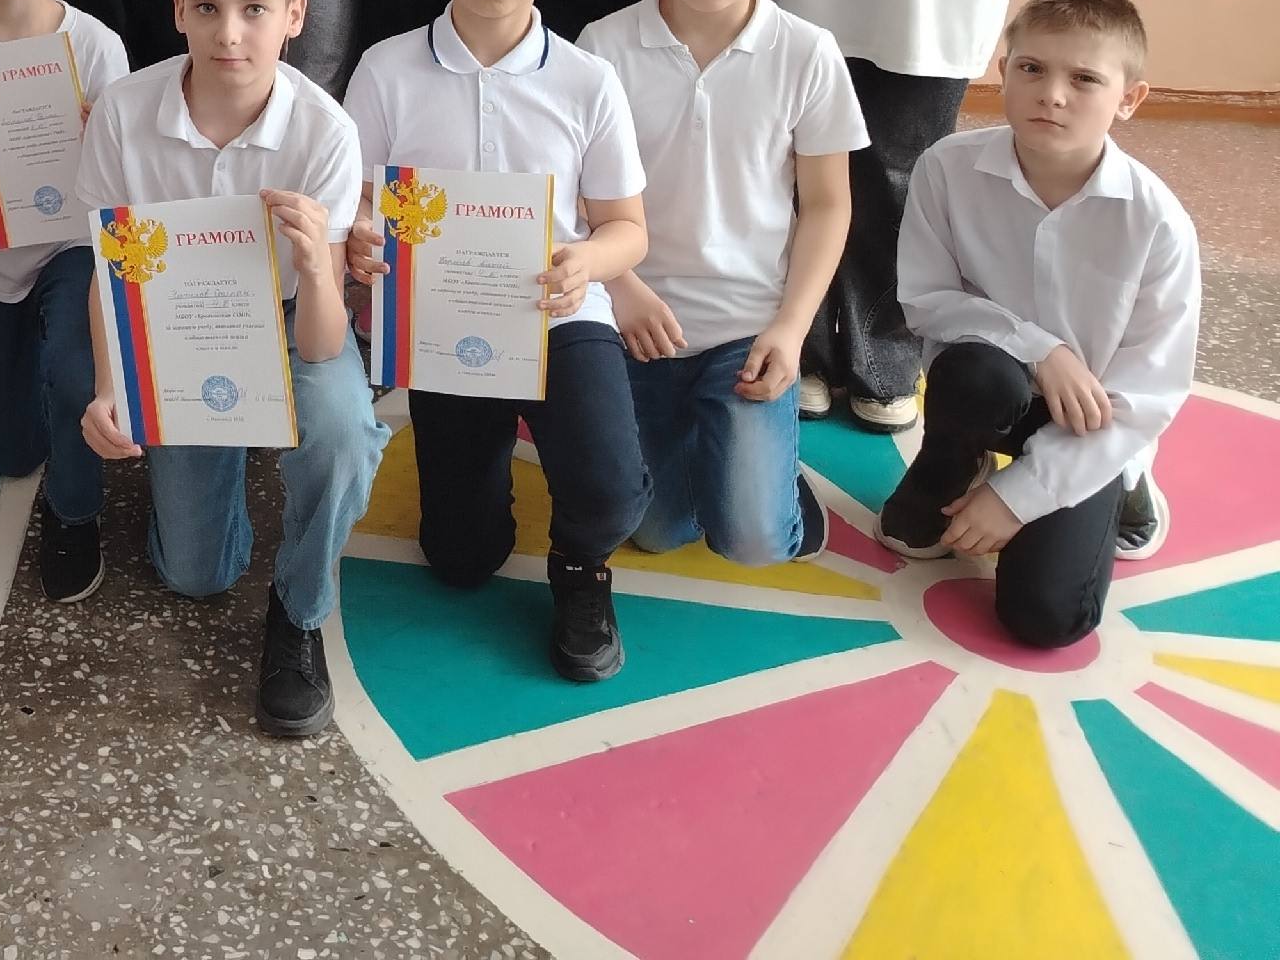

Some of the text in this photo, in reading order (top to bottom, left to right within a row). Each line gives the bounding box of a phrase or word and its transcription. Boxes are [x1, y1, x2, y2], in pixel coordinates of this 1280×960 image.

[2, 62, 63, 81] ГРАМОТА
[455, 203, 535, 220] ГРАМОТА
[176, 230, 256, 246] ГРАМОТА
